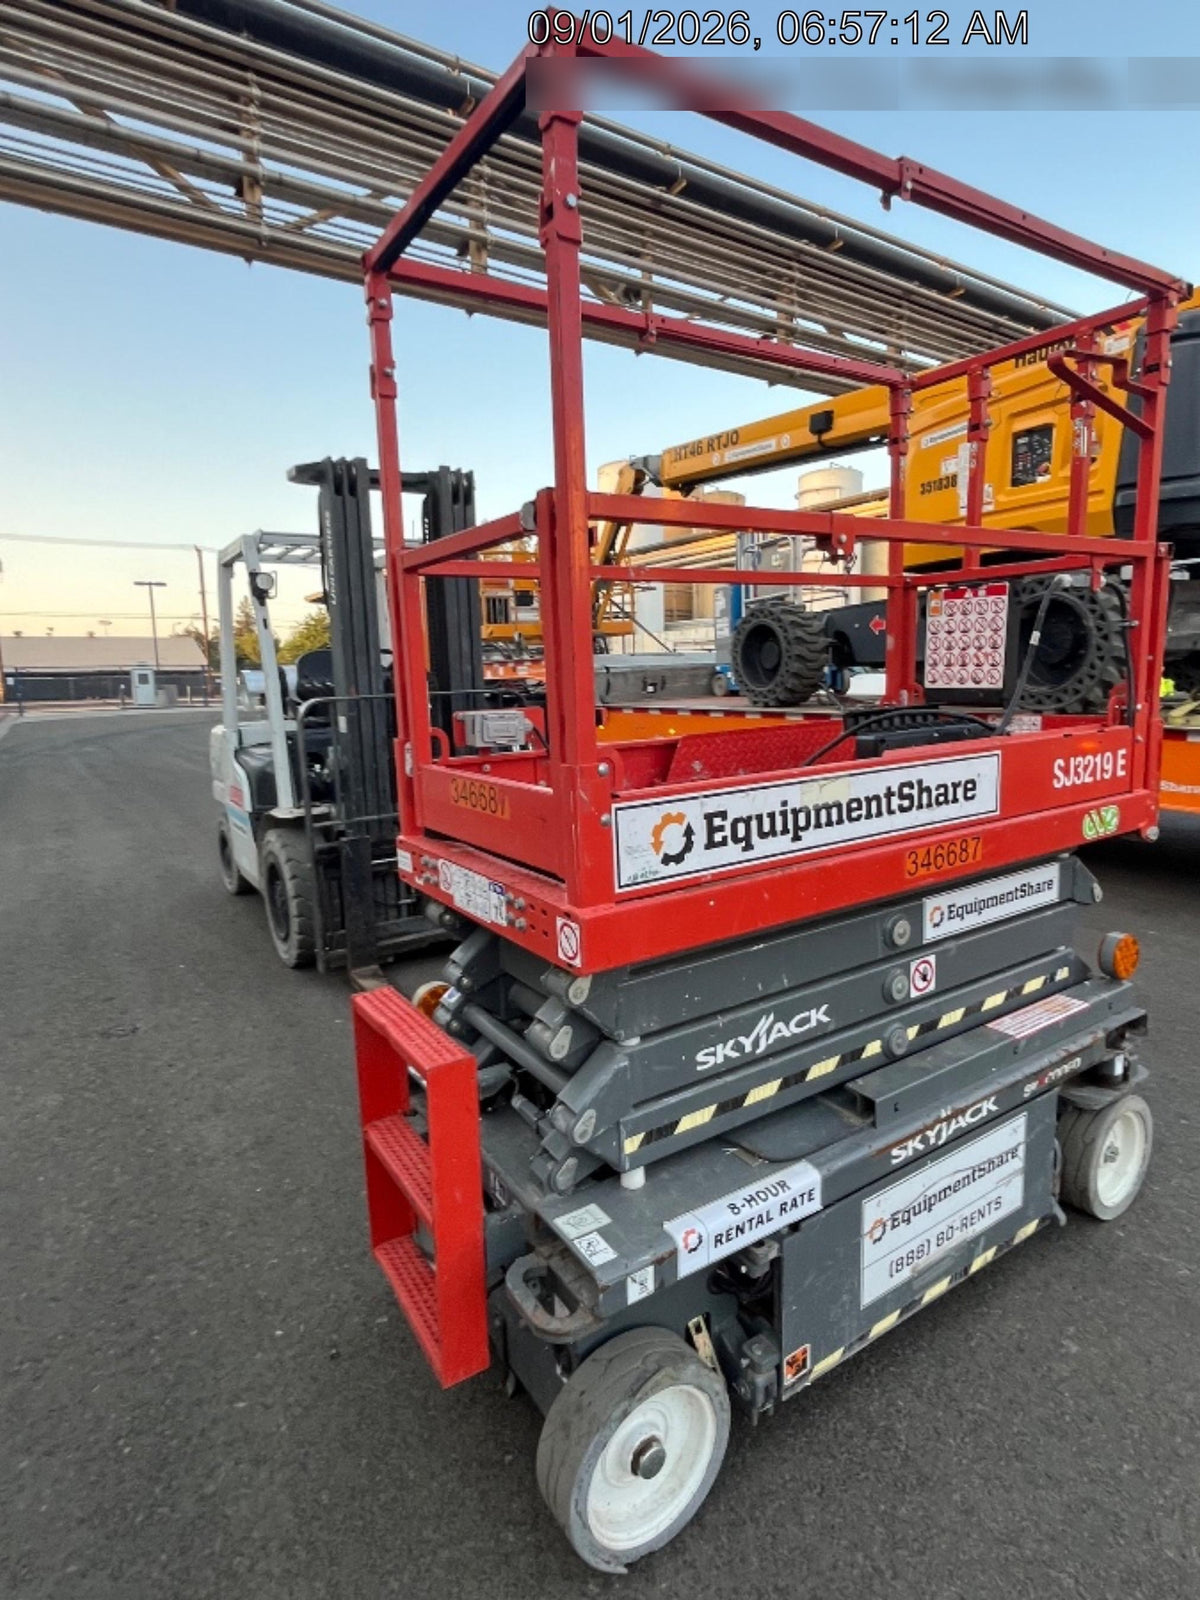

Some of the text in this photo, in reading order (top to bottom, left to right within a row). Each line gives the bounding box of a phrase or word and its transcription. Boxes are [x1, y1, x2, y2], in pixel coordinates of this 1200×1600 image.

[1052, 748, 1127, 788] SJ3219 E
[703, 778, 978, 852] EquipmentShare
[906, 836, 981, 877] 346687
[946, 878, 1054, 922] EquipmentShare
[695, 1003, 832, 1071] SKYJACK
[890, 1095, 1000, 1166] SKYJACK
[727, 1179, 792, 1216] 8-HOUR
[890, 1145, 1020, 1232] EquipmentShare
[714, 1187, 816, 1249] RENTAL RATE
[888, 1239, 931, 1279] (888)
